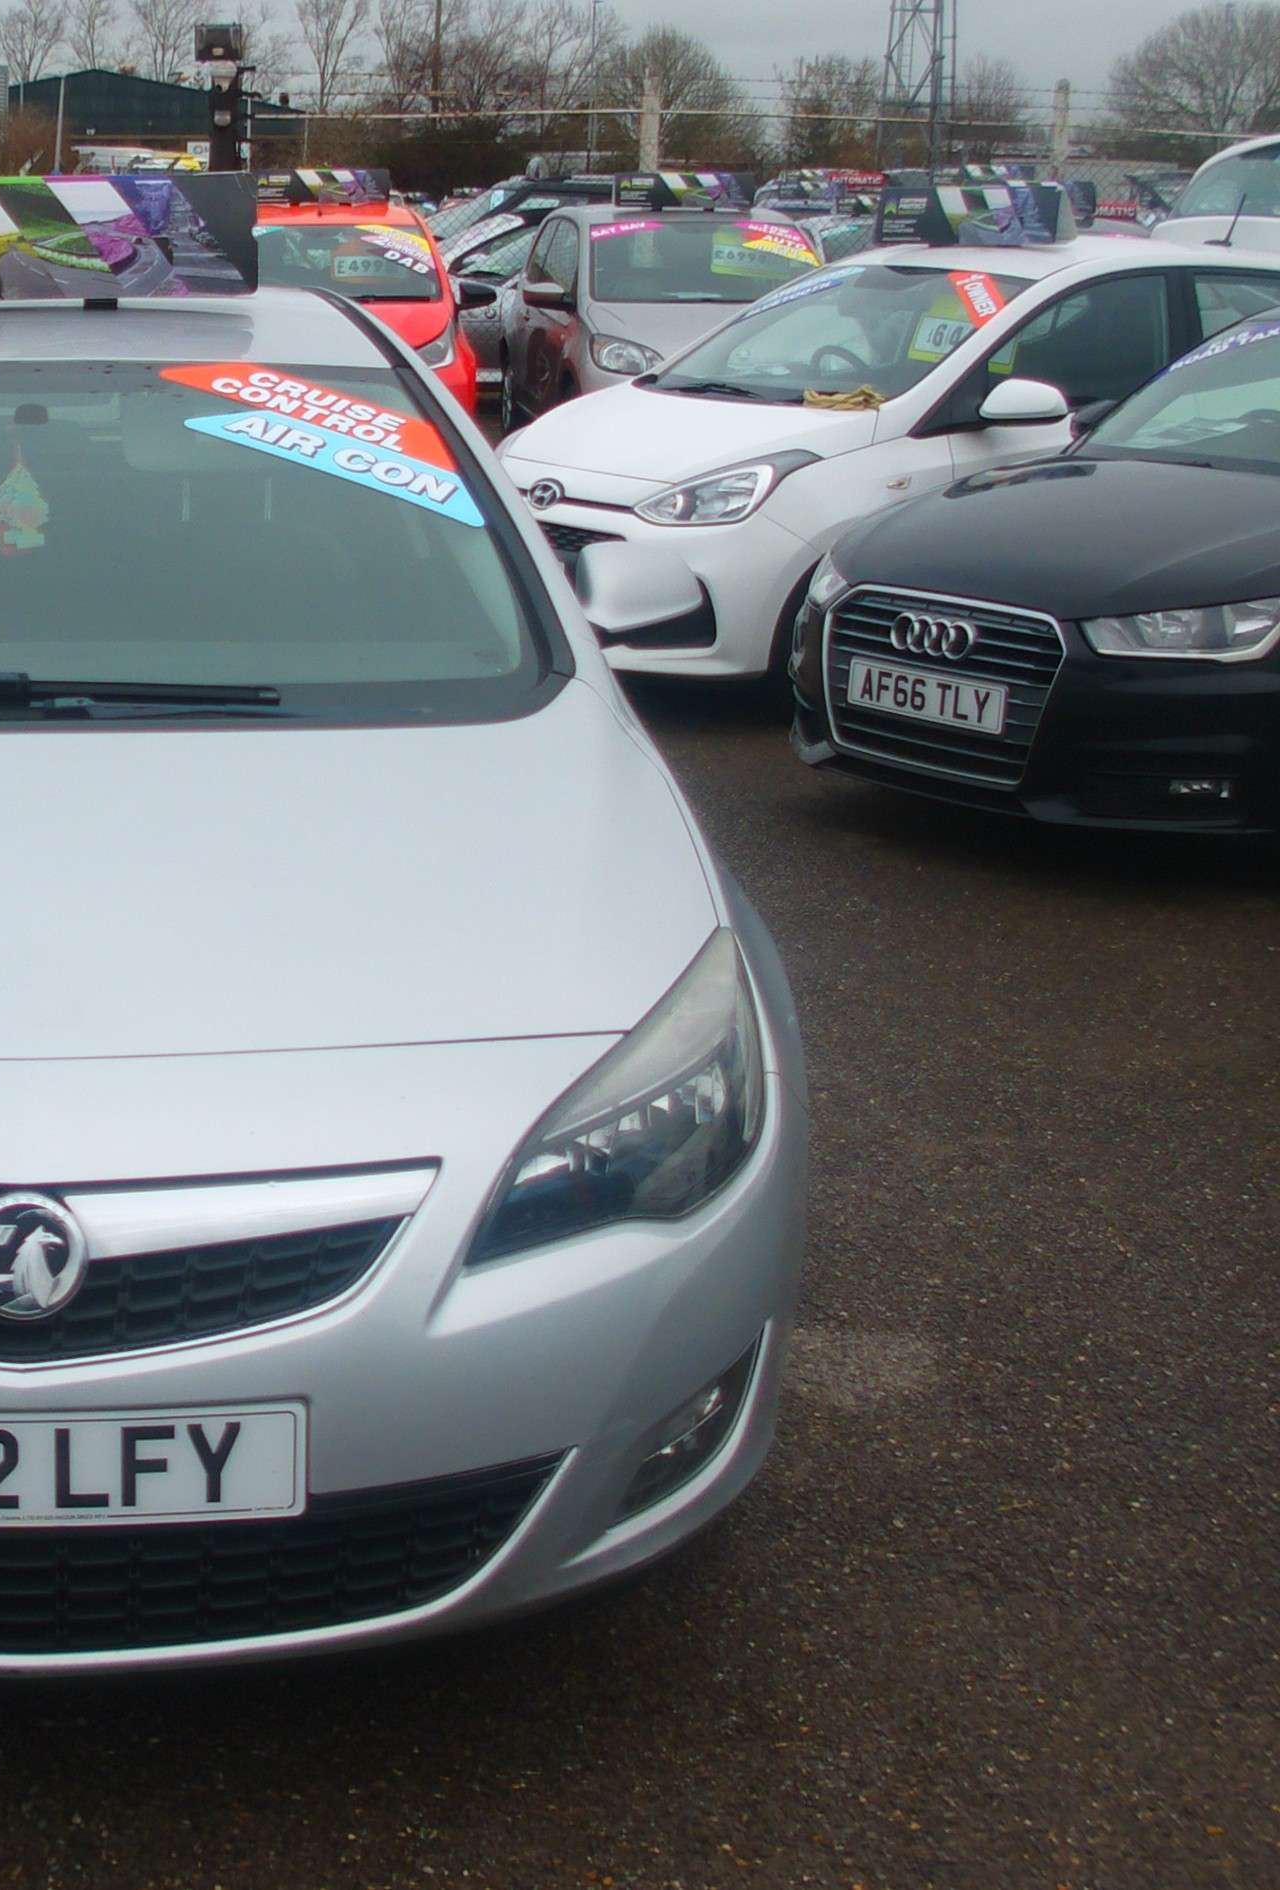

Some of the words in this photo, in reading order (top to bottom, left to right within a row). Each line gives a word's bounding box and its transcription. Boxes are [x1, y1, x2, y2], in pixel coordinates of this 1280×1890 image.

[383, 250, 430, 275] DAB
[210, 376, 405, 453] CONTROL
[247, 371, 407, 433] CRUISE
[223, 416, 326, 459] AIR
[333, 448, 459, 504] CON
[860, 667, 926, 712] AF66
[936, 682, 991, 724] TLY
[54, 1420, 242, 1510] LFY
